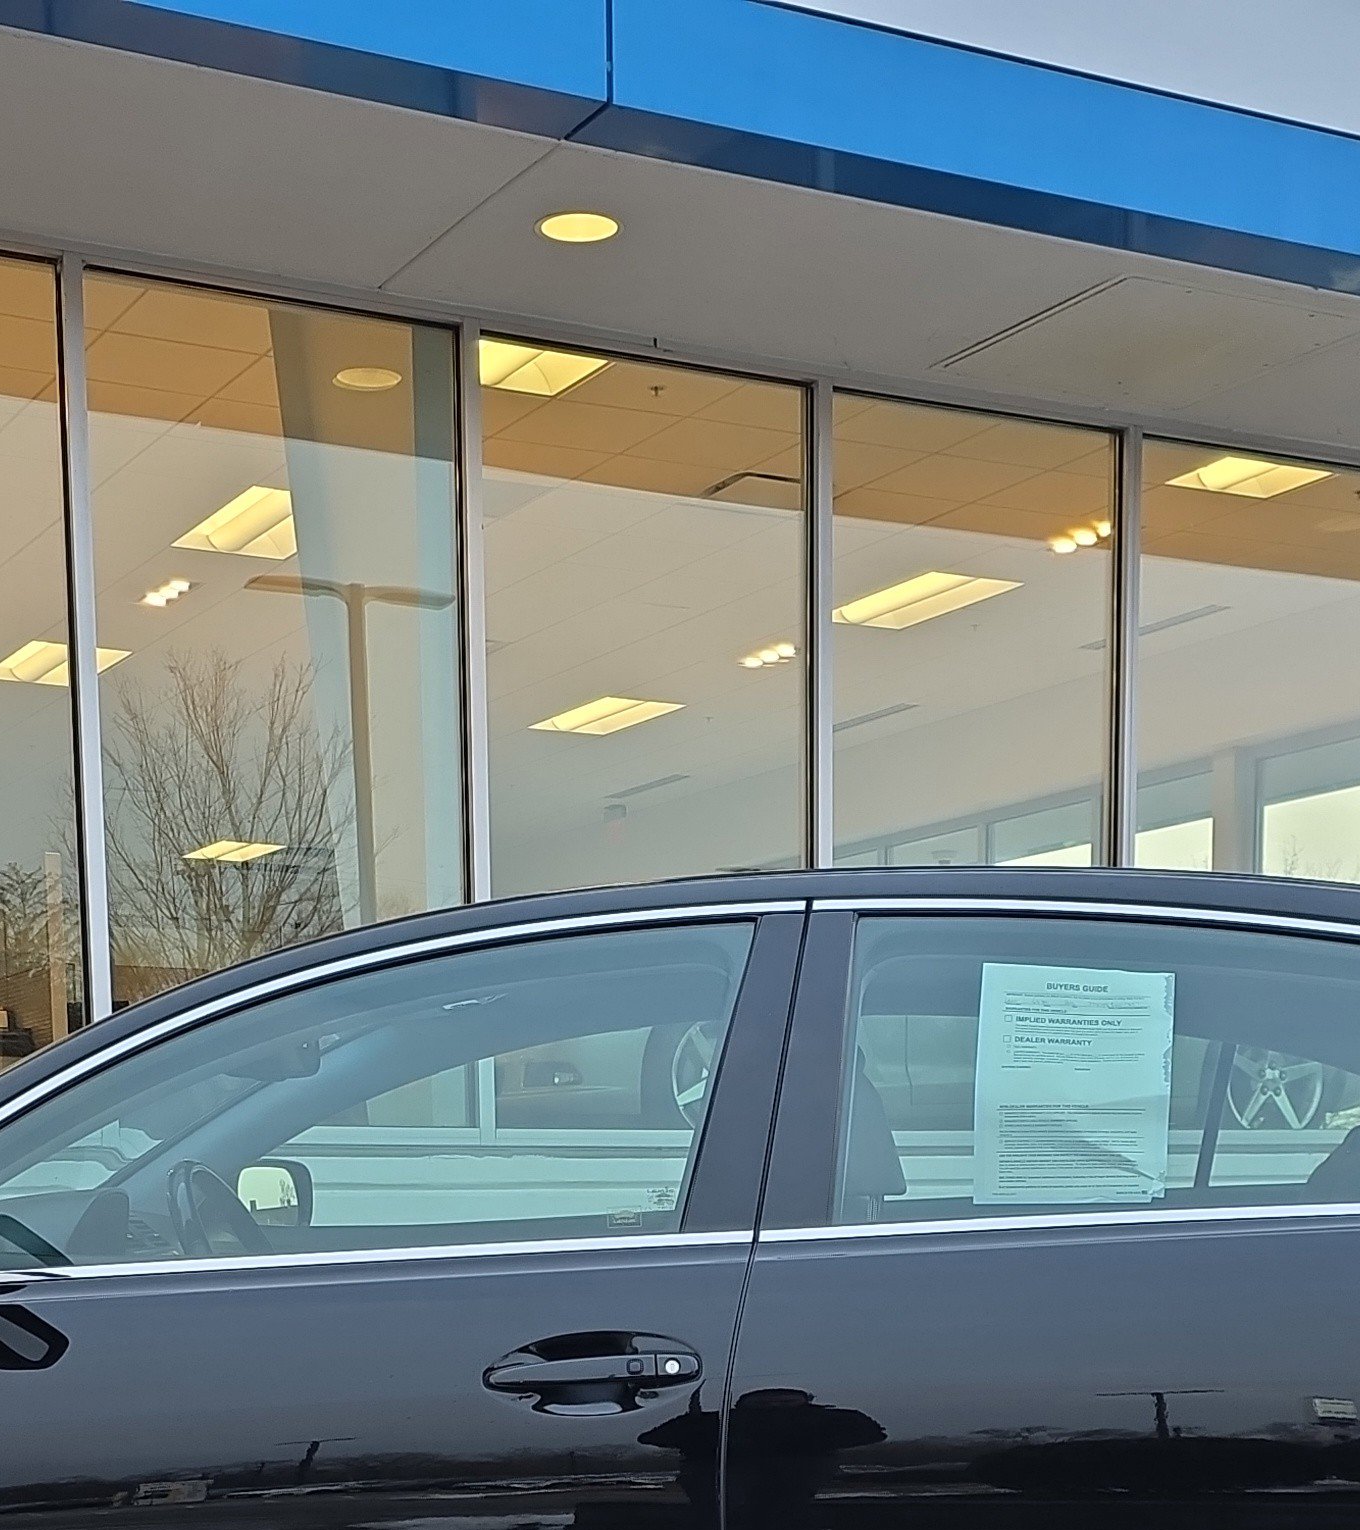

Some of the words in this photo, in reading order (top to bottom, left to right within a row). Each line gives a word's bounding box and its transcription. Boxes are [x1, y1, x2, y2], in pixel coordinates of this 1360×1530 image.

[1046, 982, 1081, 992] BUYERS
[1082, 984, 1109, 993] GUIDE
[1015, 1015, 1047, 1024] IMPLIED
[1048, 1018, 1100, 1026] WARRANTIES
[1101, 1019, 1123, 1027] ONLY
[1014, 1036, 1046, 1044] DEALER
[1047, 1038, 1093, 1047] WARRANTY
